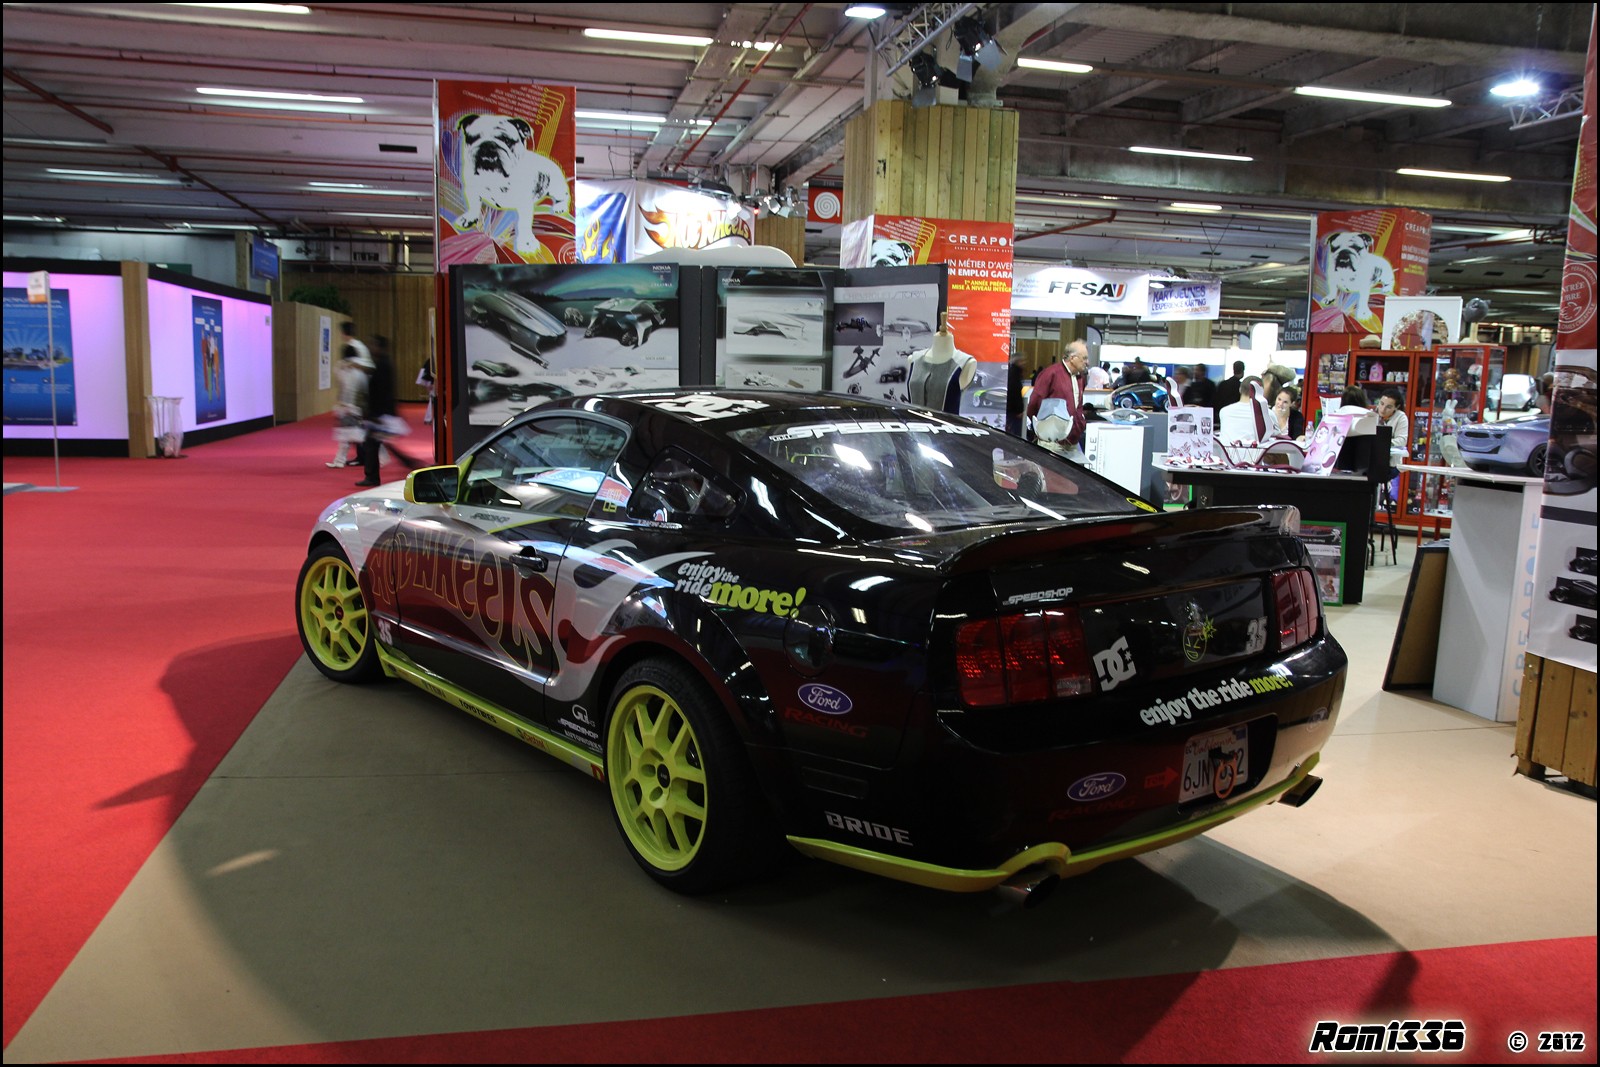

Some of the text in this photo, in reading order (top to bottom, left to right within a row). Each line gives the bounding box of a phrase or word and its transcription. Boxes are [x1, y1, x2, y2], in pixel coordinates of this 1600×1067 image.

[957, 269, 989, 277] EMPLOI
[1288, 318, 1305, 329] PISTE
[786, 421, 990, 439] SPEEDSHOP
[677, 559, 740, 584] enjoy the
[674, 576, 807, 619] ride more!
[1008, 587, 1074, 605] SPEEDSHOP
[377, 619, 393, 646] 35
[1245, 615, 1268, 655] 35
[1139, 697, 1192, 726] enjoy
[1191, 685, 1220, 710] the
[1221, 676, 1253, 702] ride
[784, 707, 869, 738] RACING
[824, 811, 914, 847] BRIDE
